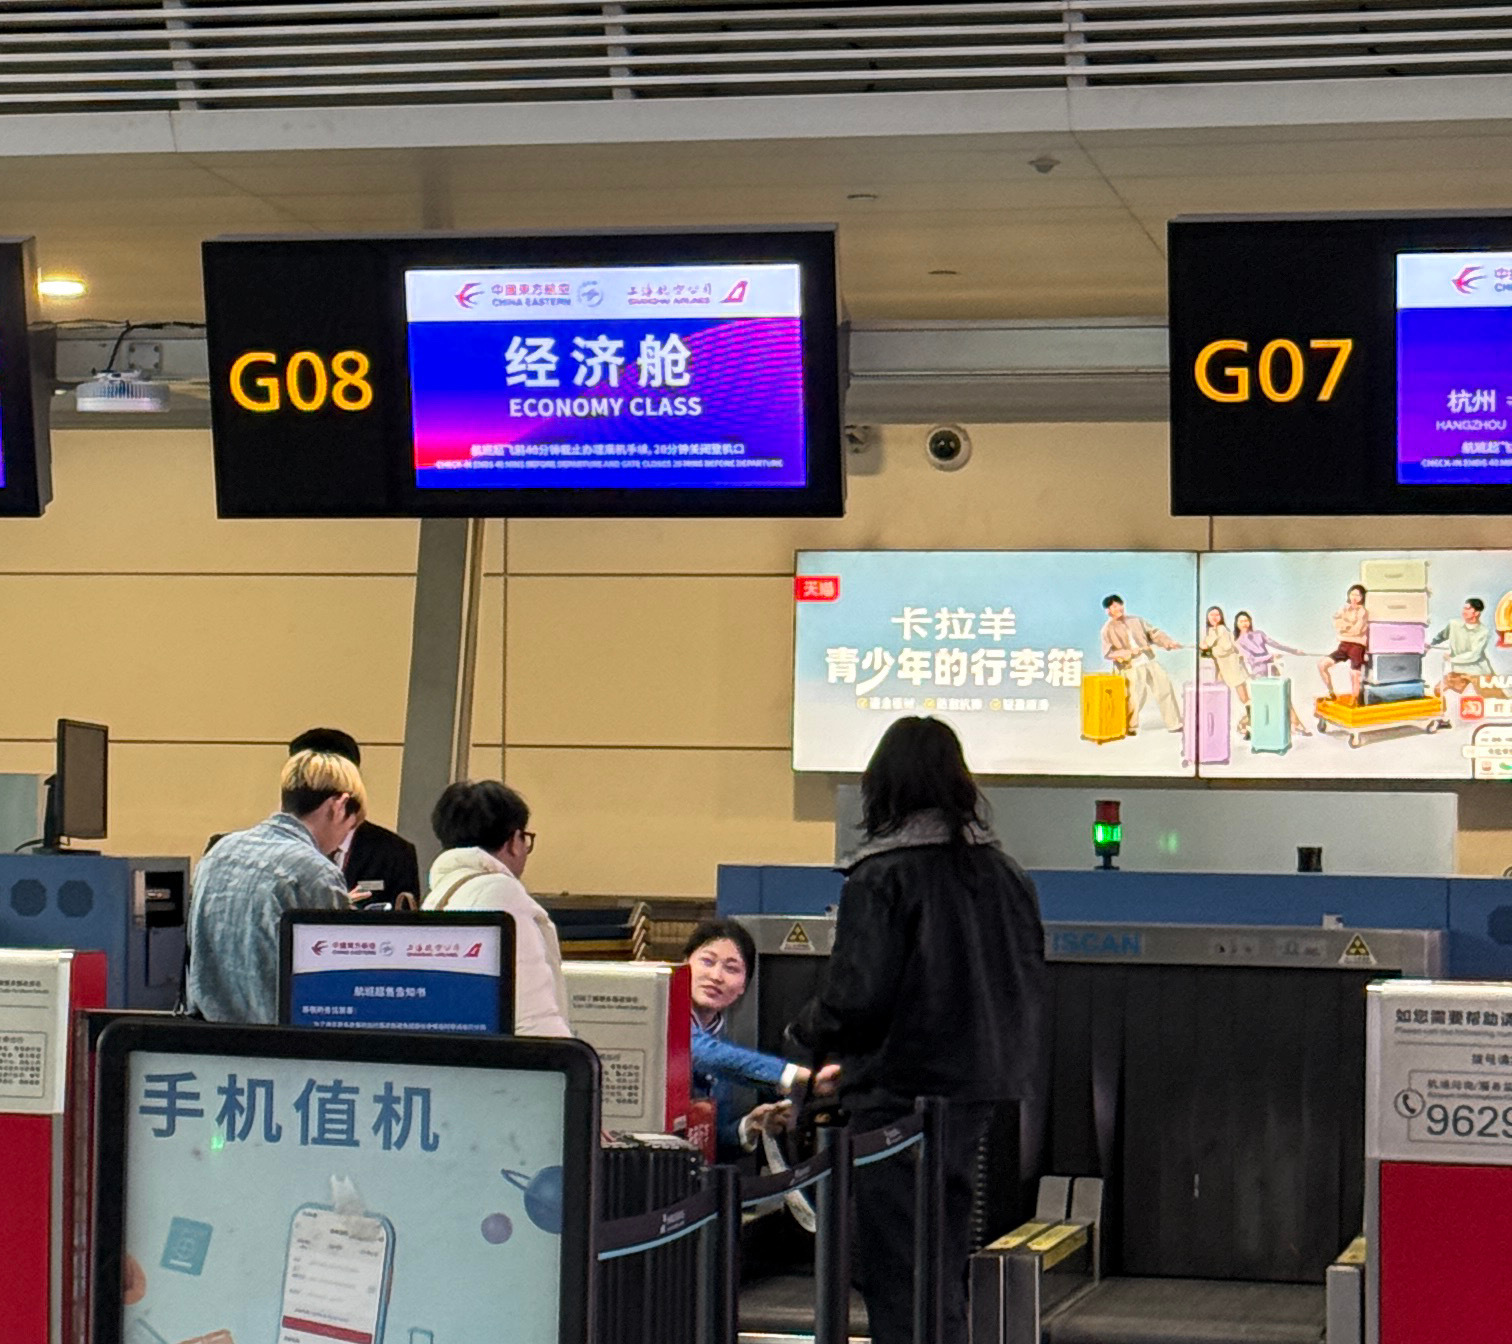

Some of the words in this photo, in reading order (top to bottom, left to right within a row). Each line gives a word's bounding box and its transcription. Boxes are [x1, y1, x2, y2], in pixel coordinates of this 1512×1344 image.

[230, 351, 373, 412] G08
[504, 333, 692, 389] 经济舱
[1194, 338, 1353, 403] G07
[509, 397, 622, 418] ECONOMY
[630, 396, 703, 417] CLASS
[1435, 419, 1507, 431] HANGZHOU
[1446, 389, 1496, 414] 杭州
[891, 606, 1016, 641] 卡拉羊
[825, 647, 1084, 696] 青少年的行李箱
[139, 1070, 439, 1153] 手机值机
